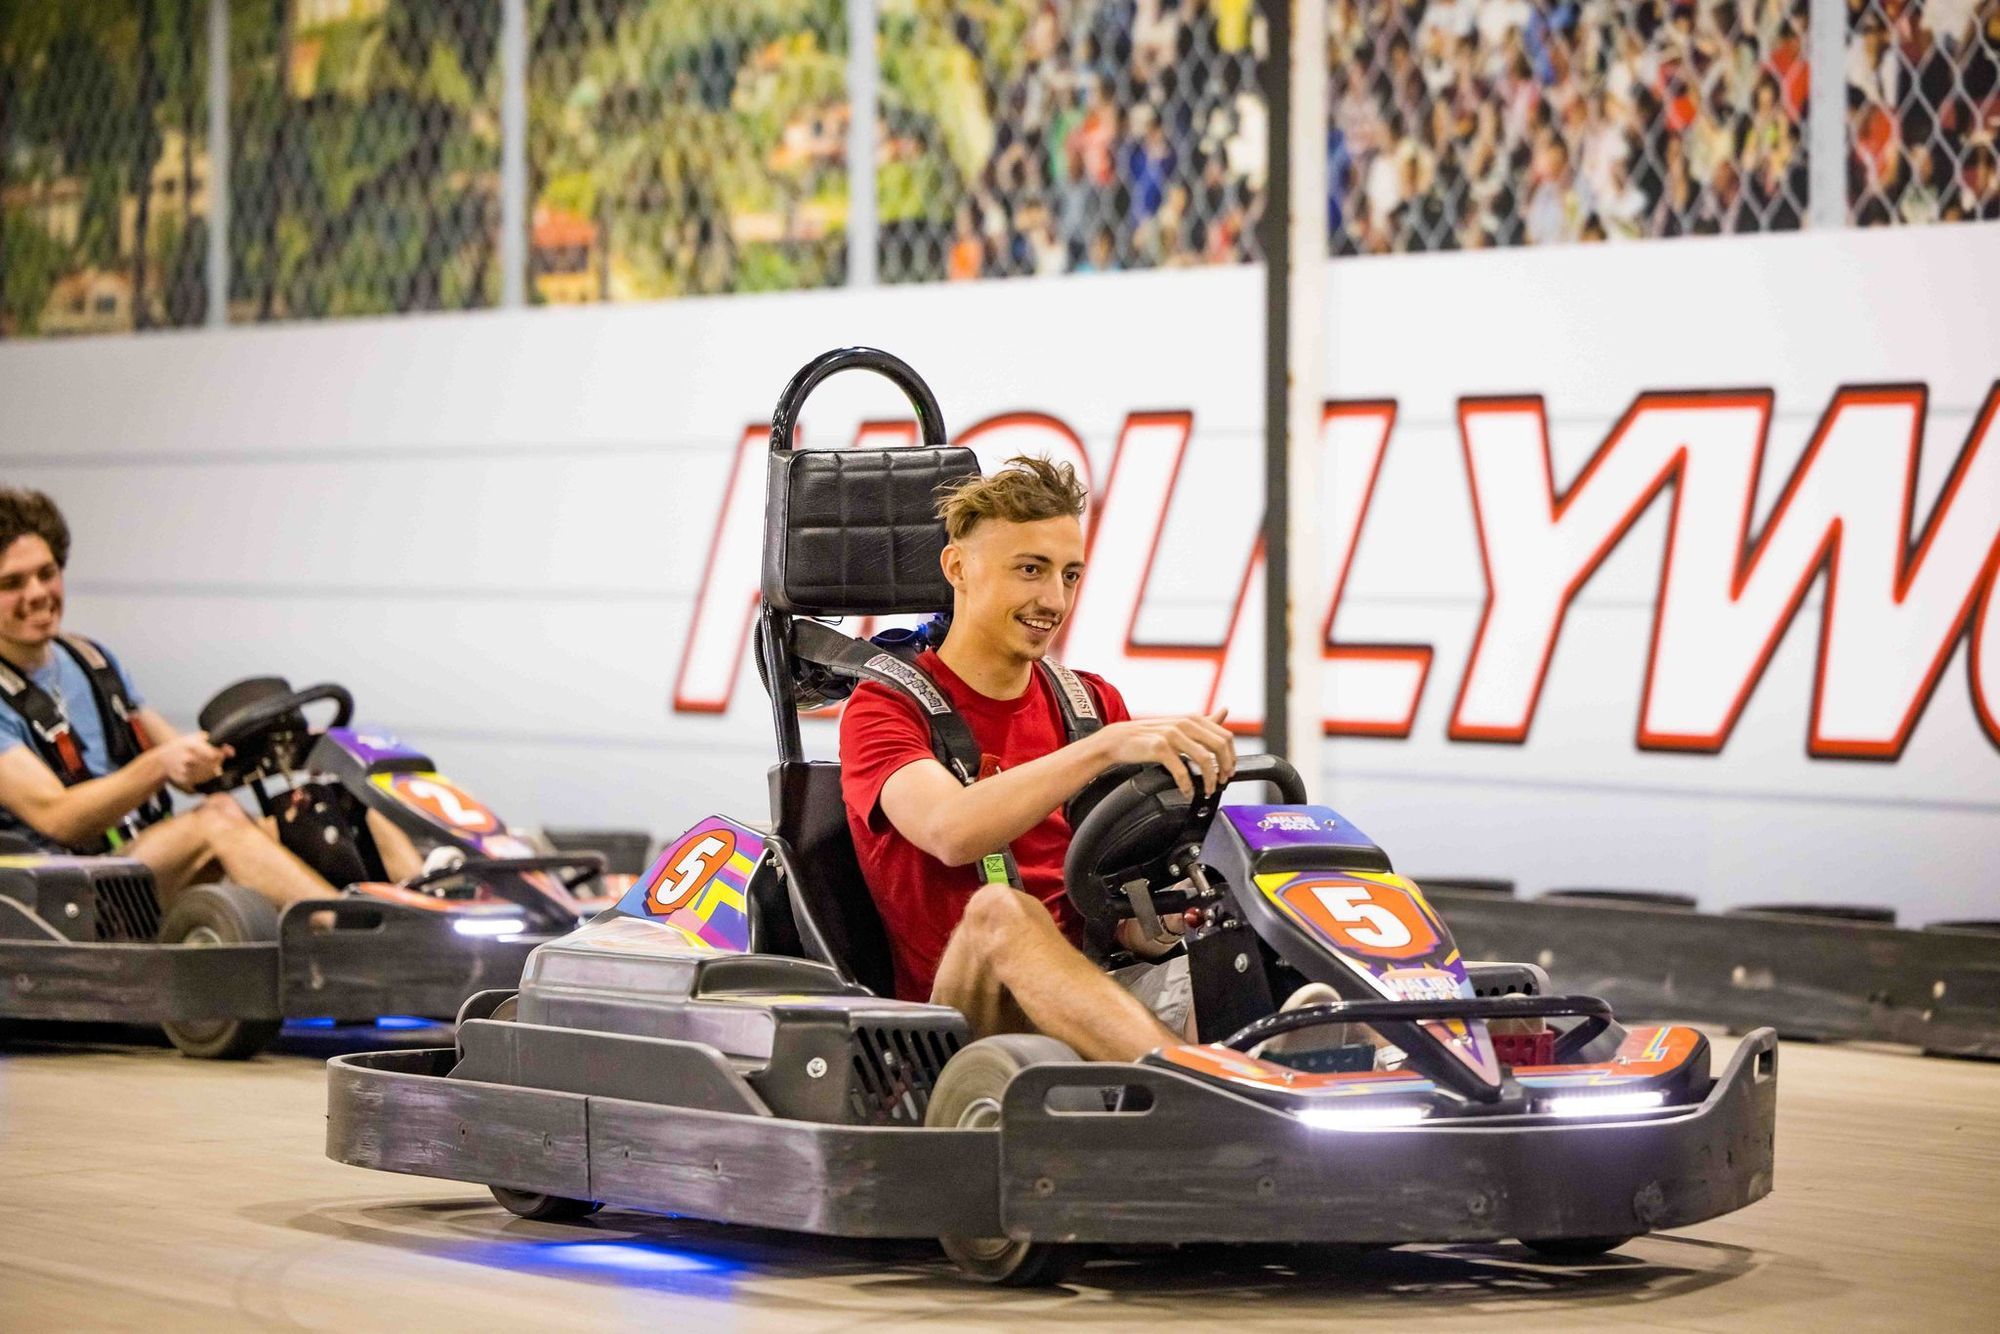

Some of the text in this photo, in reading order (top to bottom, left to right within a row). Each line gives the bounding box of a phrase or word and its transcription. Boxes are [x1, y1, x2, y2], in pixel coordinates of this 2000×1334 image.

[1071, 688, 1093, 716] FIRST
[408, 780, 487, 826] 2
[656, 836, 727, 906] 5
[1309, 886, 1412, 948] 5
[1385, 976, 1460, 992] MALIBU
